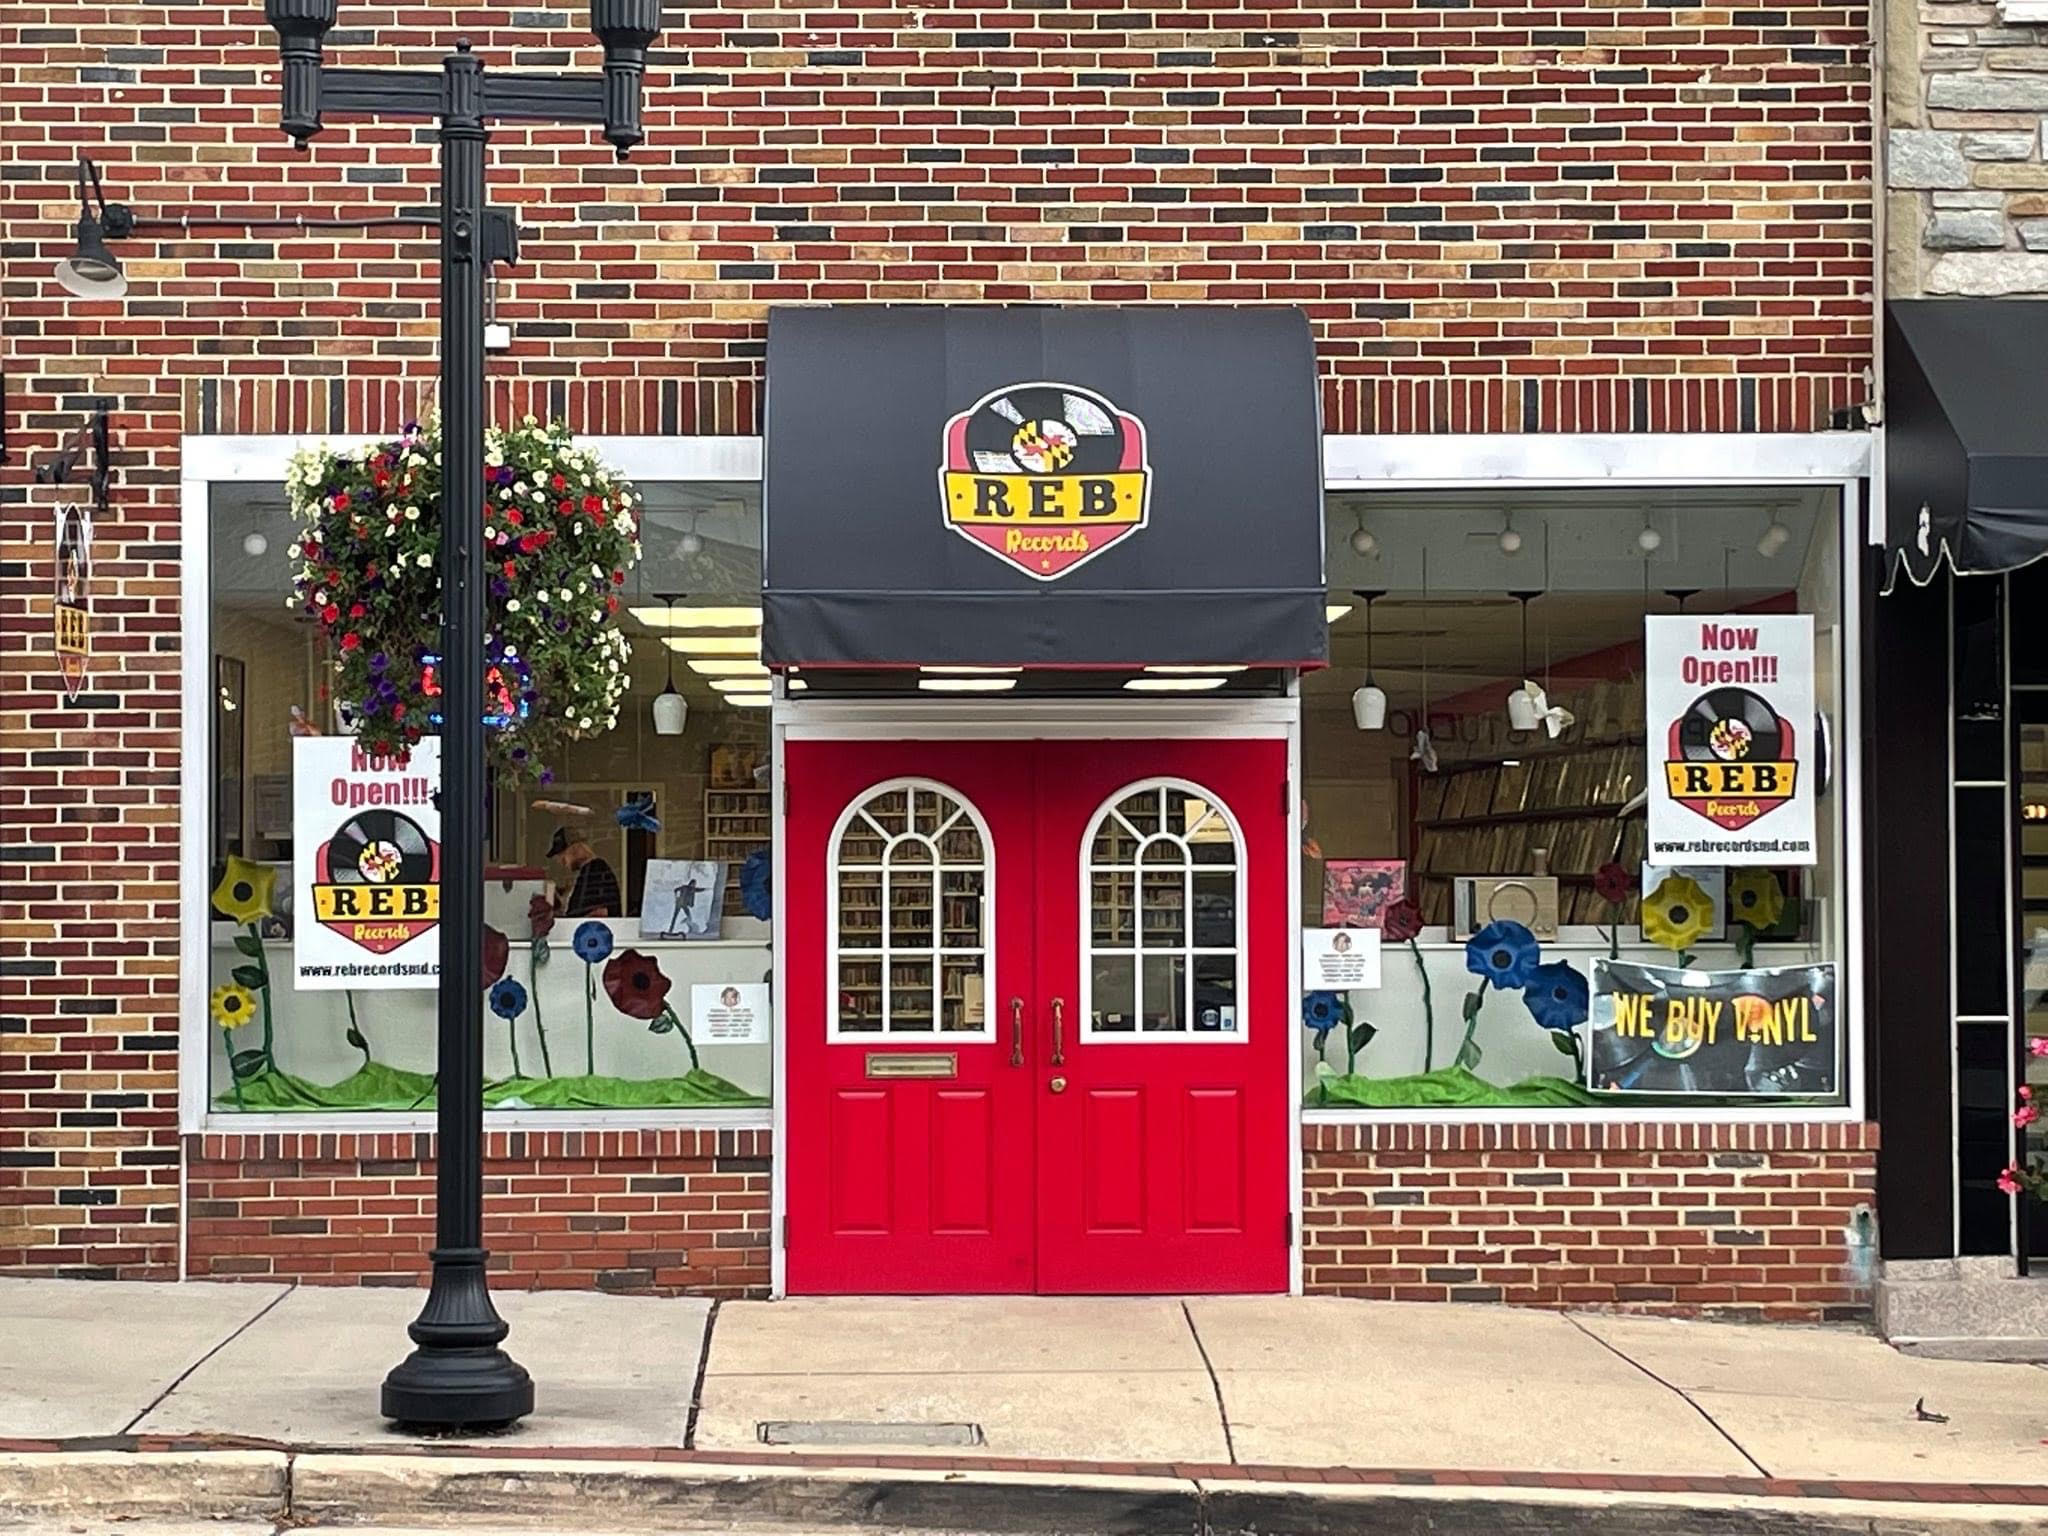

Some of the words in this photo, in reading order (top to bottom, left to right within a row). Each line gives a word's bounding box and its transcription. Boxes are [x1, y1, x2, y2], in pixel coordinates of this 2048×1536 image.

[973, 478, 1118, 517] REB
[1005, 528, 1090, 555] Records
[1701, 623, 1759, 651] Now
[1681, 655, 1779, 687] Open!!!
[331, 777, 429, 808] Open!!!
[1684, 765, 1778, 793] REB
[1706, 800, 1761, 818] Records
[1653, 839, 1811, 853] www.rebrecordsmd.com
[331, 887, 429, 916] REB
[353, 923, 410, 941] Records
[1612, 991, 1656, 1038] WE
[1666, 995, 1723, 1045] BUY
